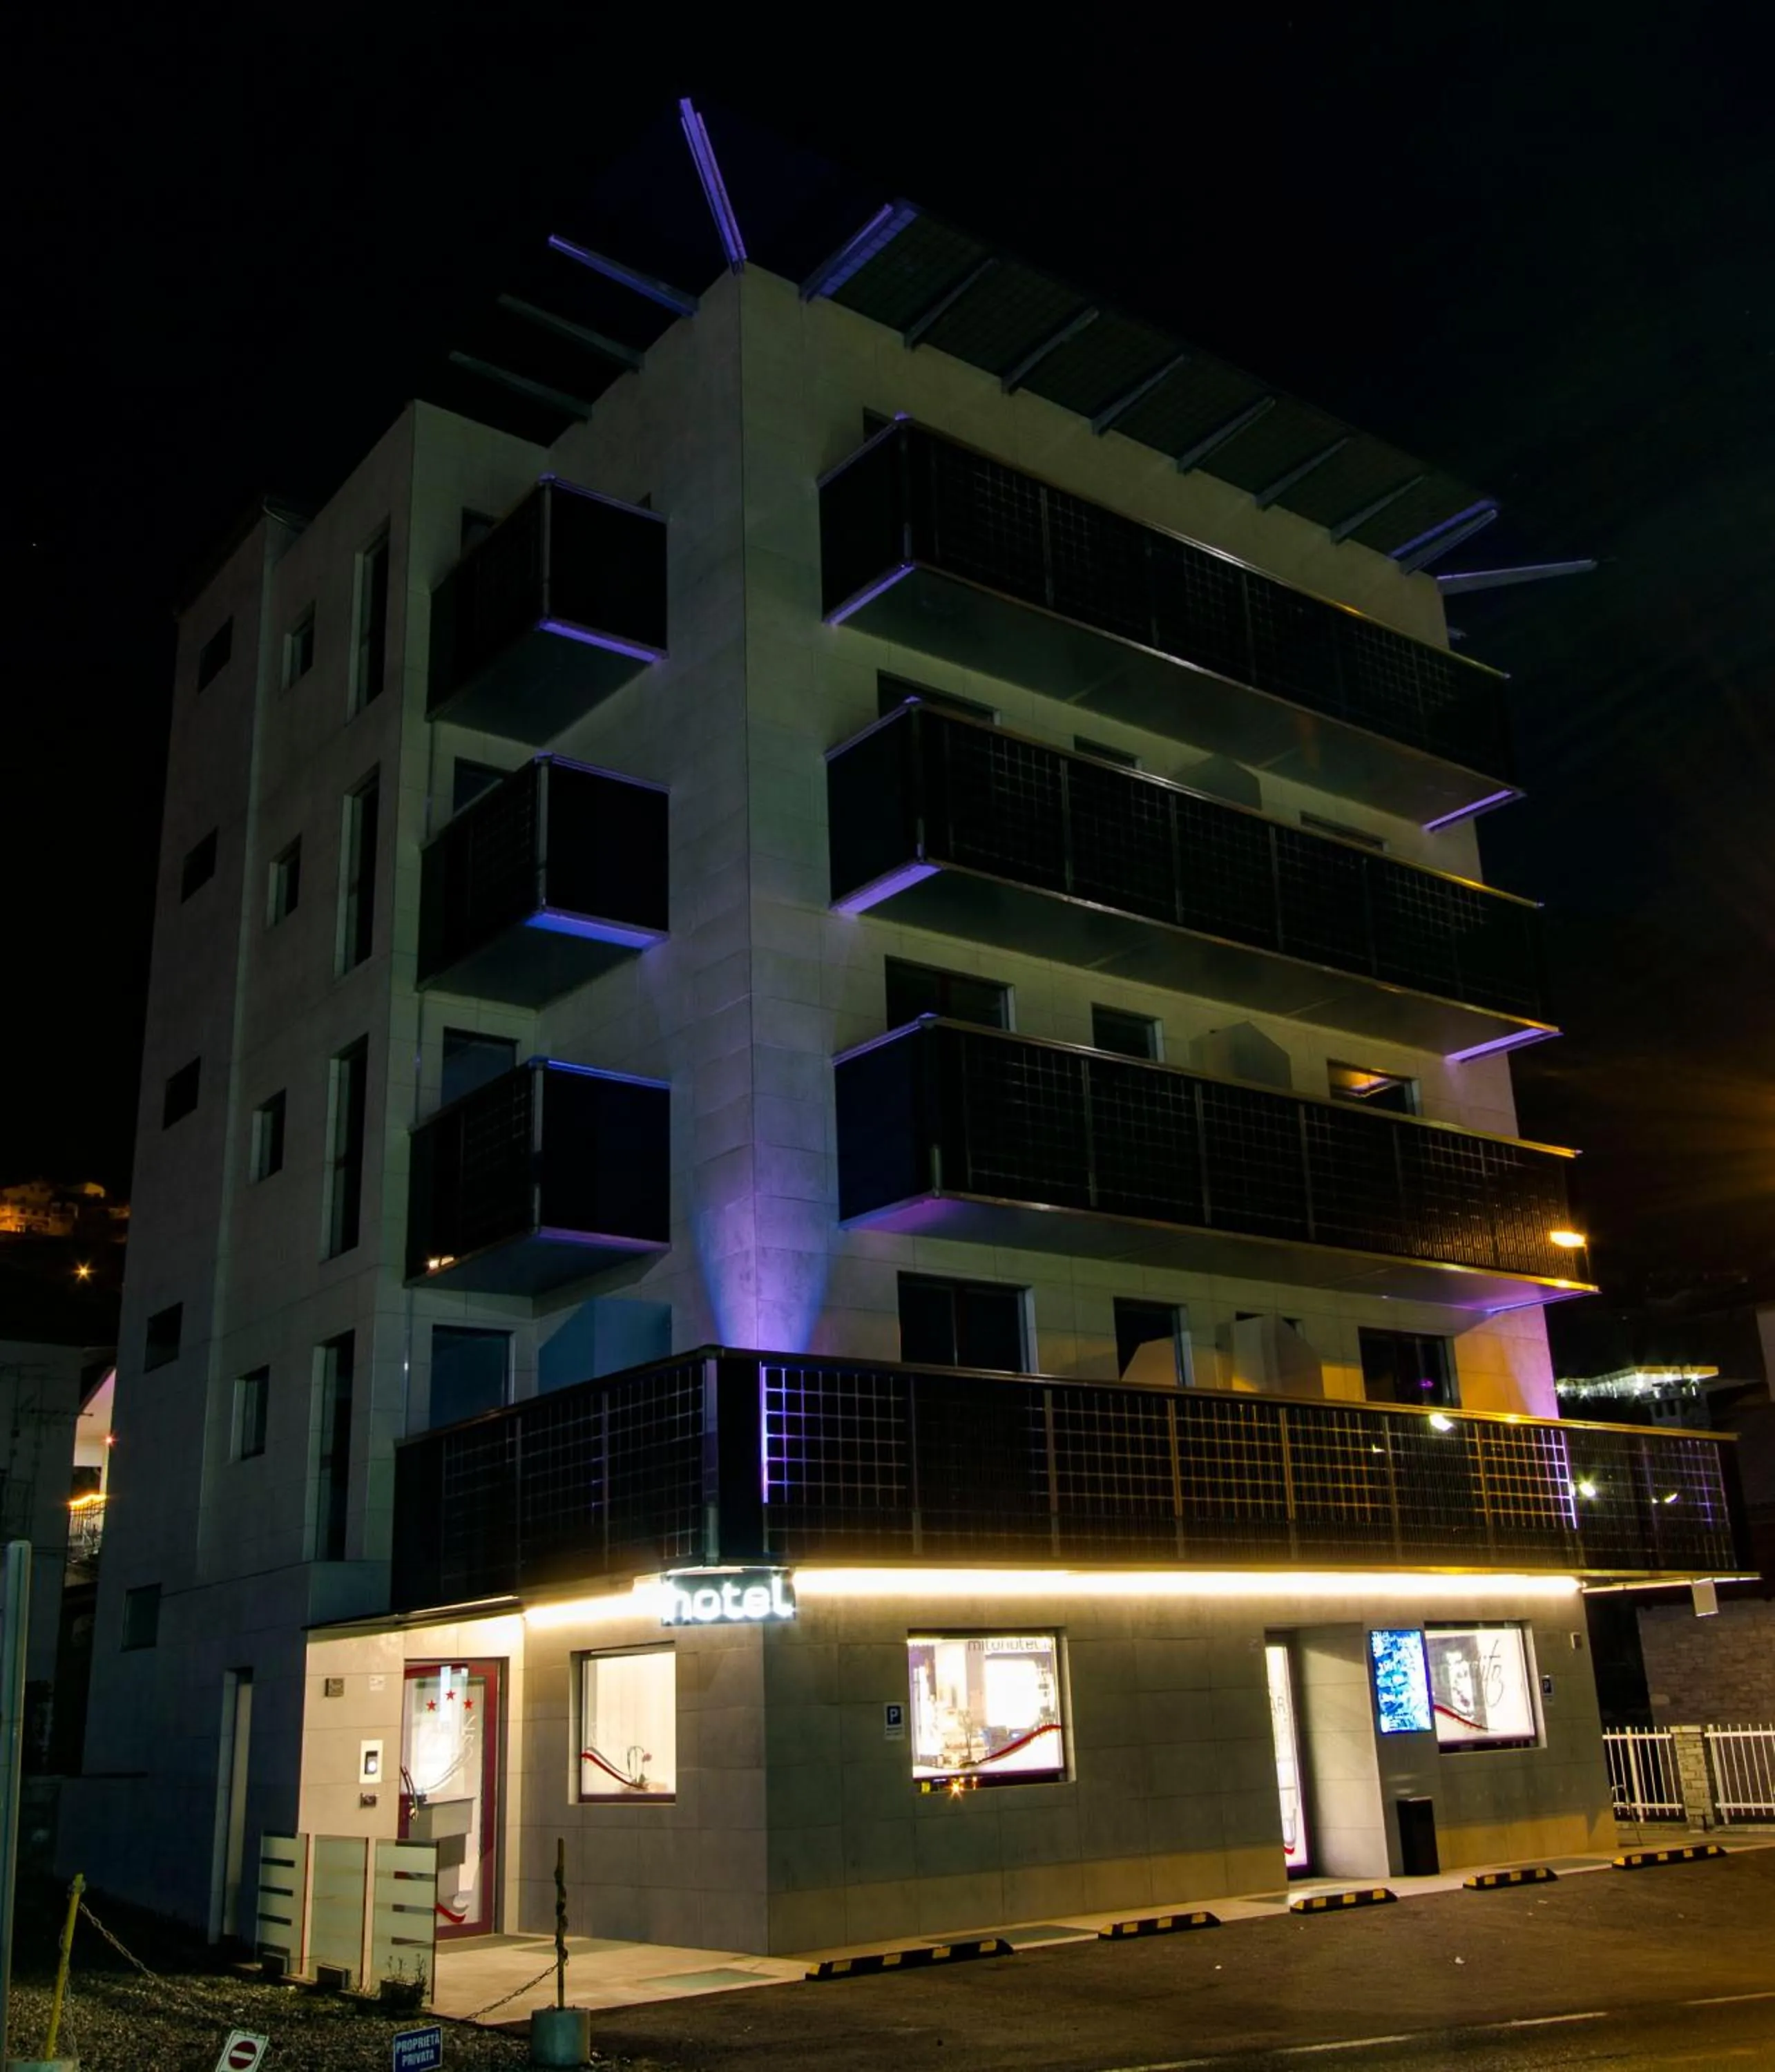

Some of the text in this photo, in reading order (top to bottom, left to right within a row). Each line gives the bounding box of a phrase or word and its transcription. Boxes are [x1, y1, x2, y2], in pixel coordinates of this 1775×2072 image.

[663, 1575, 796, 1624] hotel
[889, 1708, 899, 1723] P
[401, 2049, 434, 2067] PRIVATA
